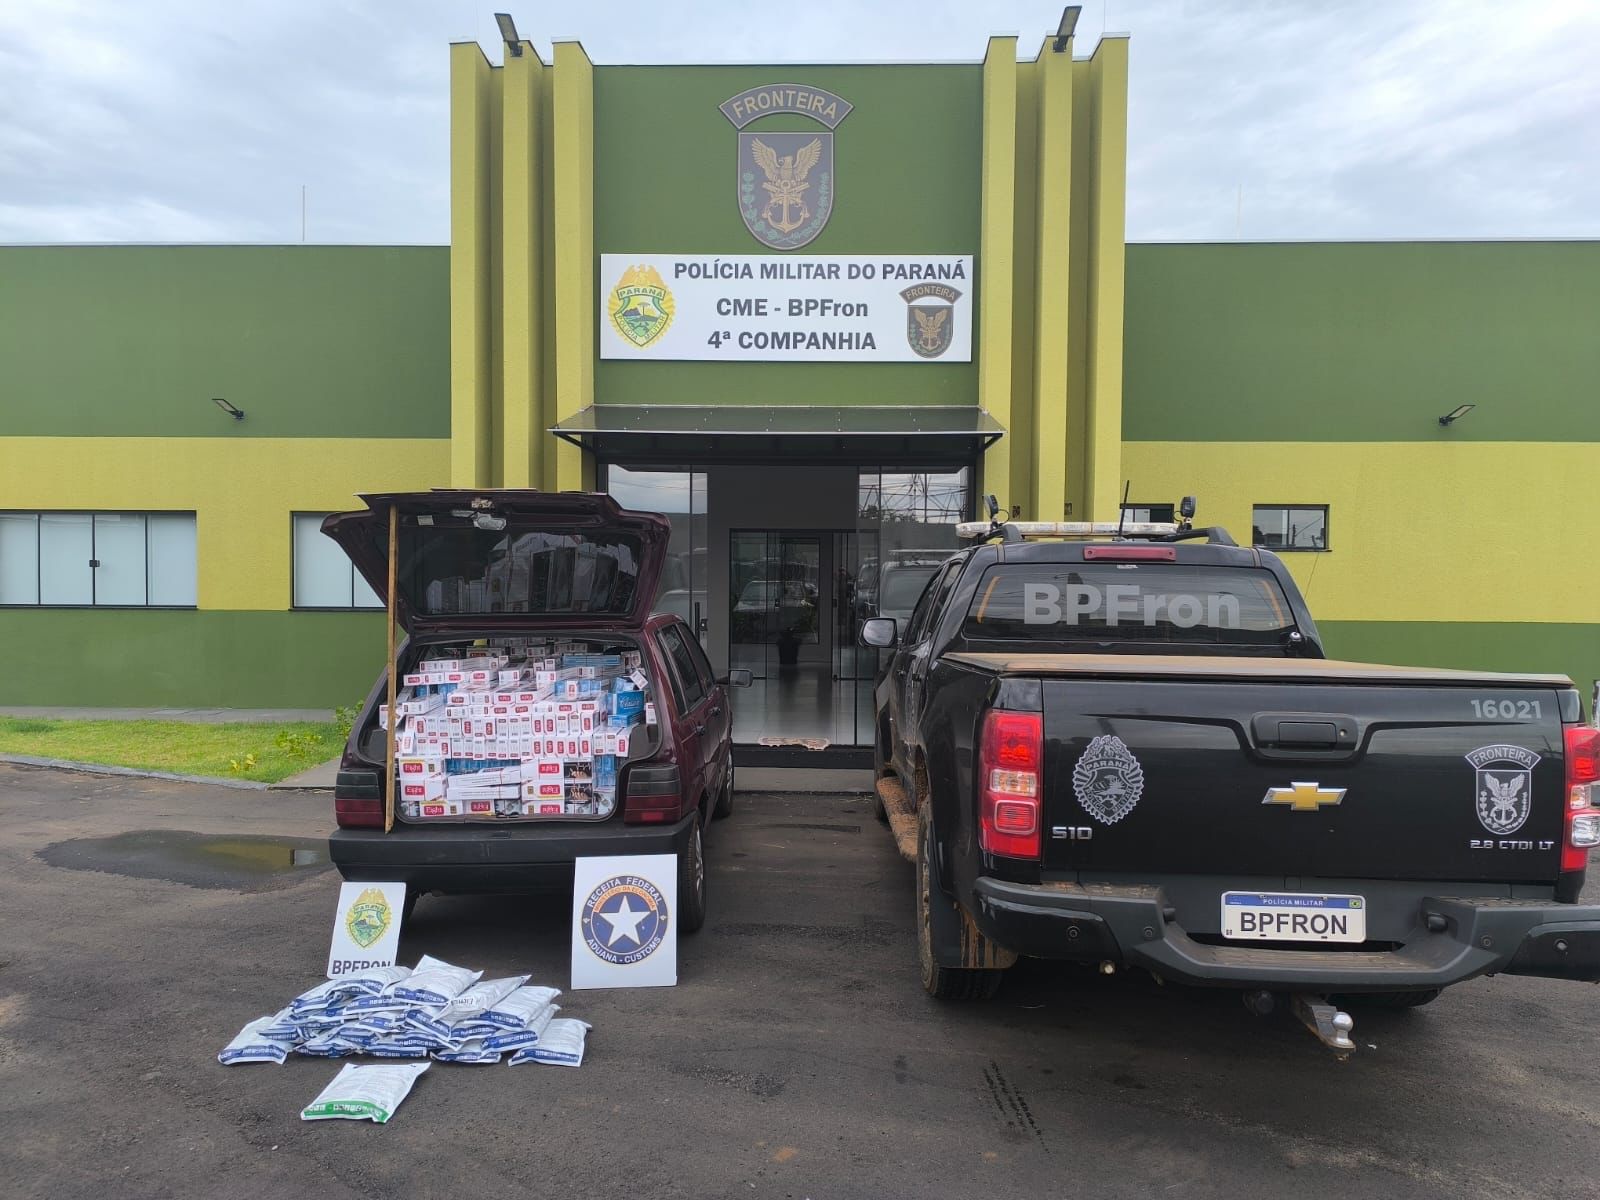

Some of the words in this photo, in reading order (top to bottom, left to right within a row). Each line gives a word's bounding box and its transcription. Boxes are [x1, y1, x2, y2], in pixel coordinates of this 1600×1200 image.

[732, 89, 838, 120] FRONTEIRA
[674, 259, 754, 280] POLÍCIA
[760, 263, 841, 280] MILITAR
[847, 263, 876, 280] DO
[882, 259, 966, 280] PARANÁ
[905, 285, 955, 300] FRONTEIRA
[716, 298, 768, 317] CME
[788, 298, 868, 317] BPFron
[707, 331, 731, 349] 4ª
[738, 331, 877, 350] COMPANHIA
[1023, 582, 1240, 629] BPFron
[1471, 699, 1542, 719] 16021
[1472, 747, 1533, 766] FRONTEIRA
[1052, 826, 1093, 840] S10
[1498, 840, 1533, 850] CTDI
[1538, 841, 1555, 850] LT
[586, 878, 622, 908] RECEITA
[626, 877, 663, 905] FEDERAL
[1263, 896, 1293, 905] POLÍCIA
[1294, 899, 1324, 907] MILITAR
[1240, 911, 1347, 935] BPFRON
[587, 938, 618, 963] ADUANA
[624, 936, 661, 963] CUSTOMS
